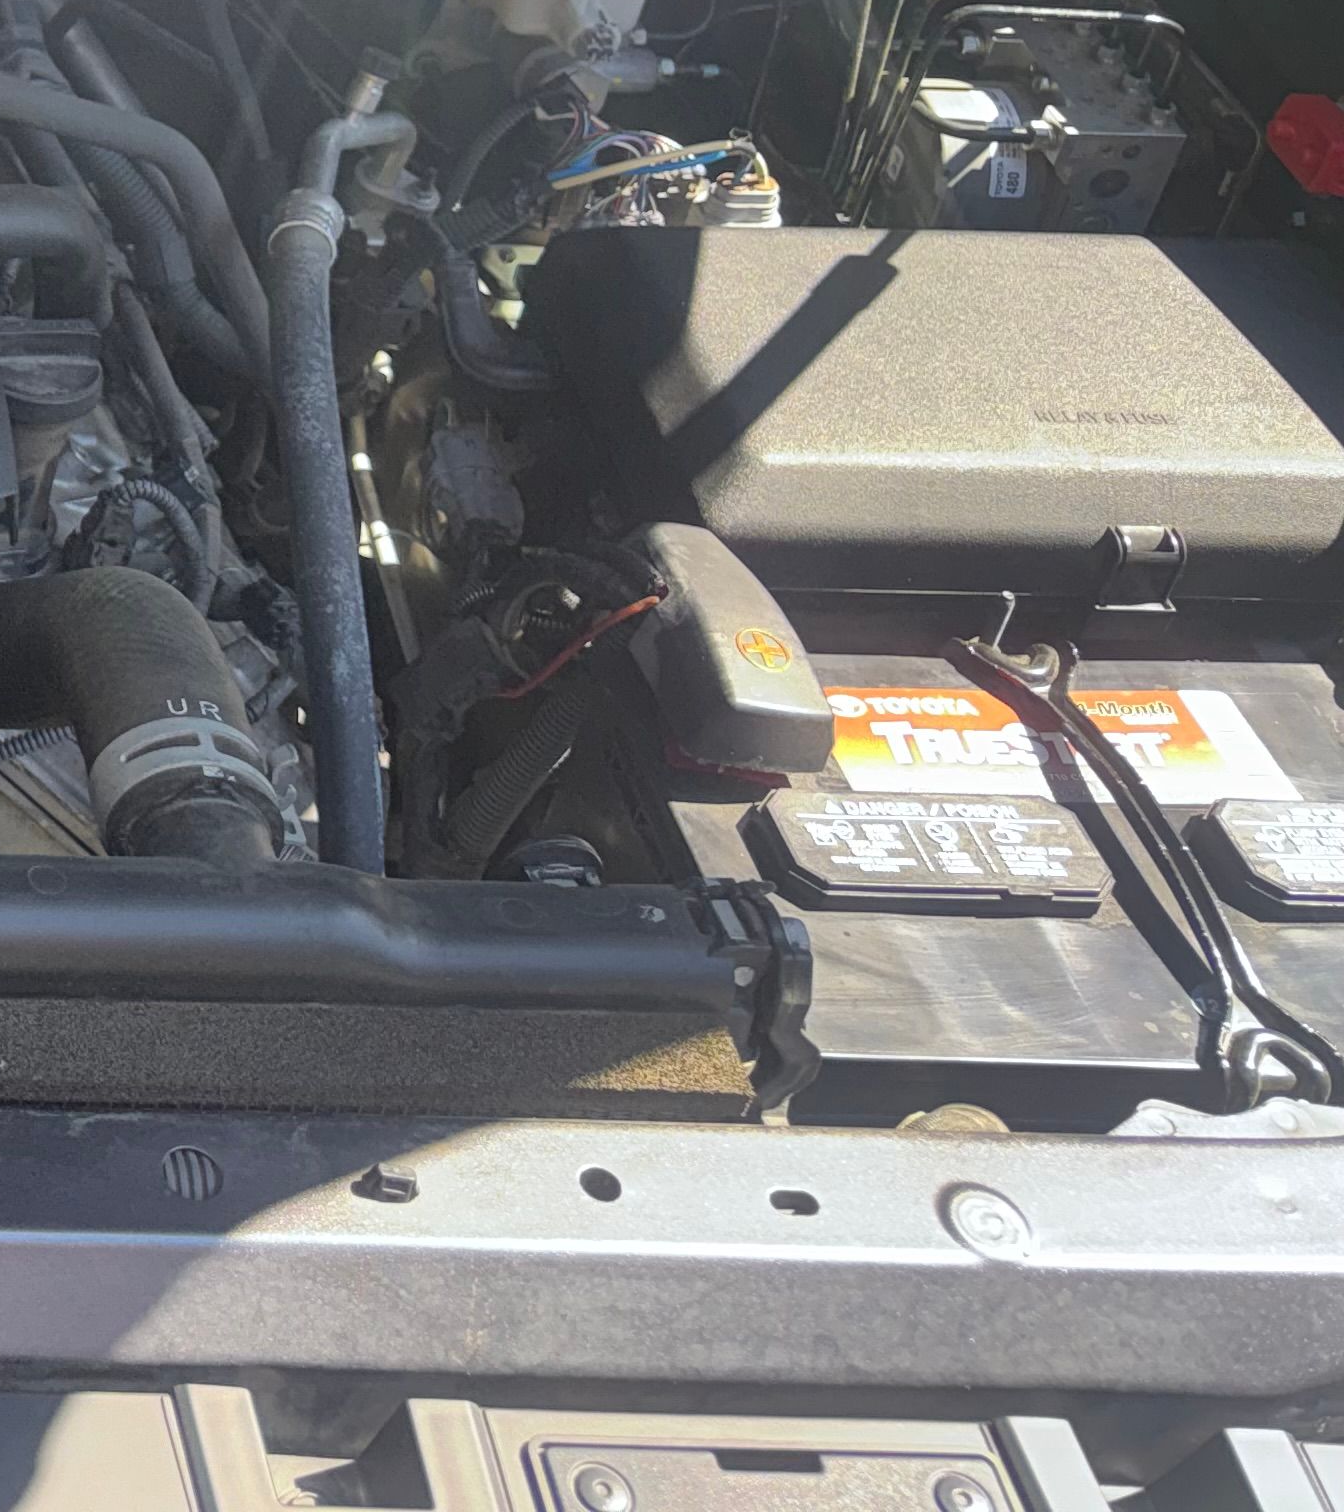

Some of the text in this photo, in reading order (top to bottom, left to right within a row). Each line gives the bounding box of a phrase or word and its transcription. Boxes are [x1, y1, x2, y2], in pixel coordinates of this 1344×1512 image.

[865, 696, 981, 717] TOYOTA
[841, 799, 927, 817] DANGER
[941, 802, 1021, 820] POISON
